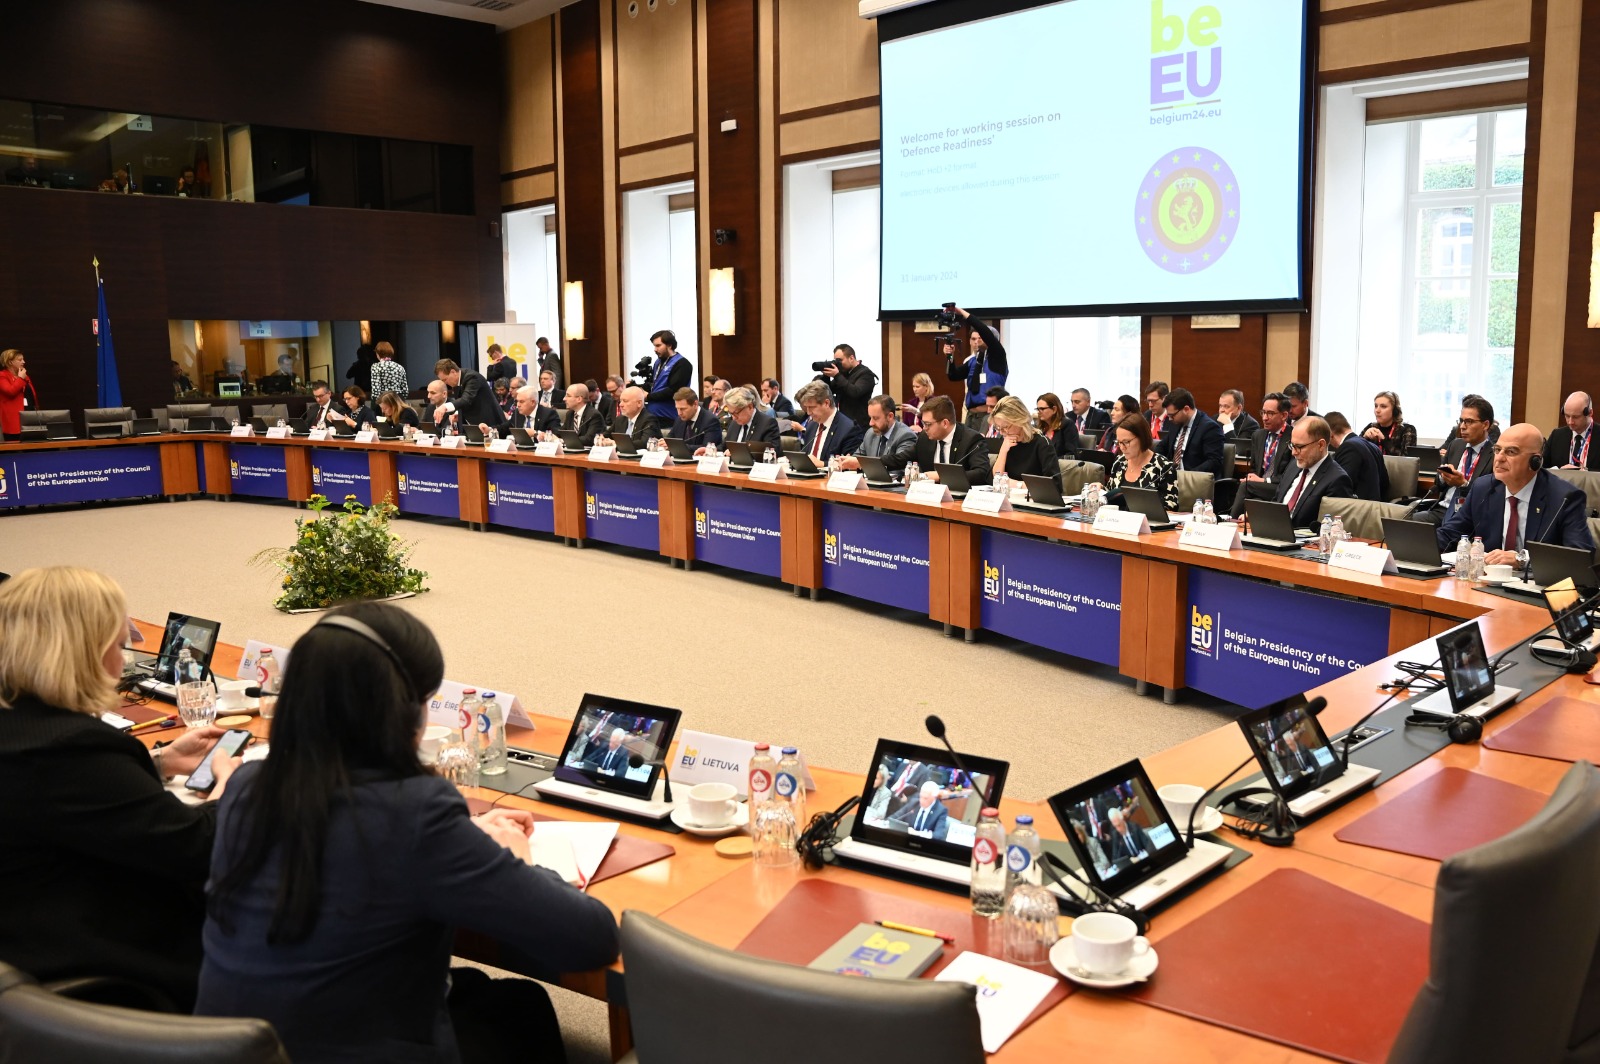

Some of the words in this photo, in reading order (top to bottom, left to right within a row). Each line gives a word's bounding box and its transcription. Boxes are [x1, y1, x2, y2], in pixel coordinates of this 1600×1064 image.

[1151, 0, 1222, 54] be
[1150, 46, 1222, 104] EU
[1150, 108, 1222, 125] belgium24.eu
[900, 130, 944, 144] Welcome
[946, 128, 959, 137] for
[962, 120, 1002, 134] working
[1006, 114, 1044, 128] session
[1047, 112, 1061, 122] on
[900, 274, 909, 283] 31
[911, 272, 938, 284] January
[940, 270, 958, 280] 2024
[60, 470, 102, 478] Presidency
[586, 492, 595, 504] be
[587, 504, 595, 514] EU
[696, 508, 706, 522] be
[696, 521, 706, 533] EU
[710, 519, 726, 528] Belgian
[727, 523, 751, 533] Presidency
[722, 530, 741, 538] European
[825, 529, 836, 546] be
[825, 544, 836, 559] EU
[843, 544, 862, 553] Belgian
[863, 548, 893, 561] Presidency
[857, 556, 880, 567] European
[881, 560, 897, 570] Union
[984, 560, 999, 580] be
[984, 578, 999, 595] EU
[1007, 578, 1031, 591] Belgian
[1033, 584, 1071, 601] Presidency
[1081, 596, 1094, 605] the
[1015, 590, 1024, 599] the
[1026, 594, 1055, 608] European
[1057, 601, 1077, 612] Union
[1192, 604, 1212, 630] be
[1191, 626, 1212, 648] EU
[1224, 628, 1256, 645] Belgian
[1260, 638, 1313, 661] Presidency
[1316, 653, 1326, 663] of
[1328, 655, 1345, 667] the
[1224, 642, 1232, 650] of
[1233, 645, 1247, 655] the
[1249, 649, 1290, 667] European
[1292, 660, 1320, 675] Union
[431, 700, 441, 709] EU
[685, 744, 698, 757] be
[682, 756, 696, 766] EU
[702, 757, 740, 772] LIETUVA
[862, 932, 911, 954] be
[850, 946, 902, 965] EU
